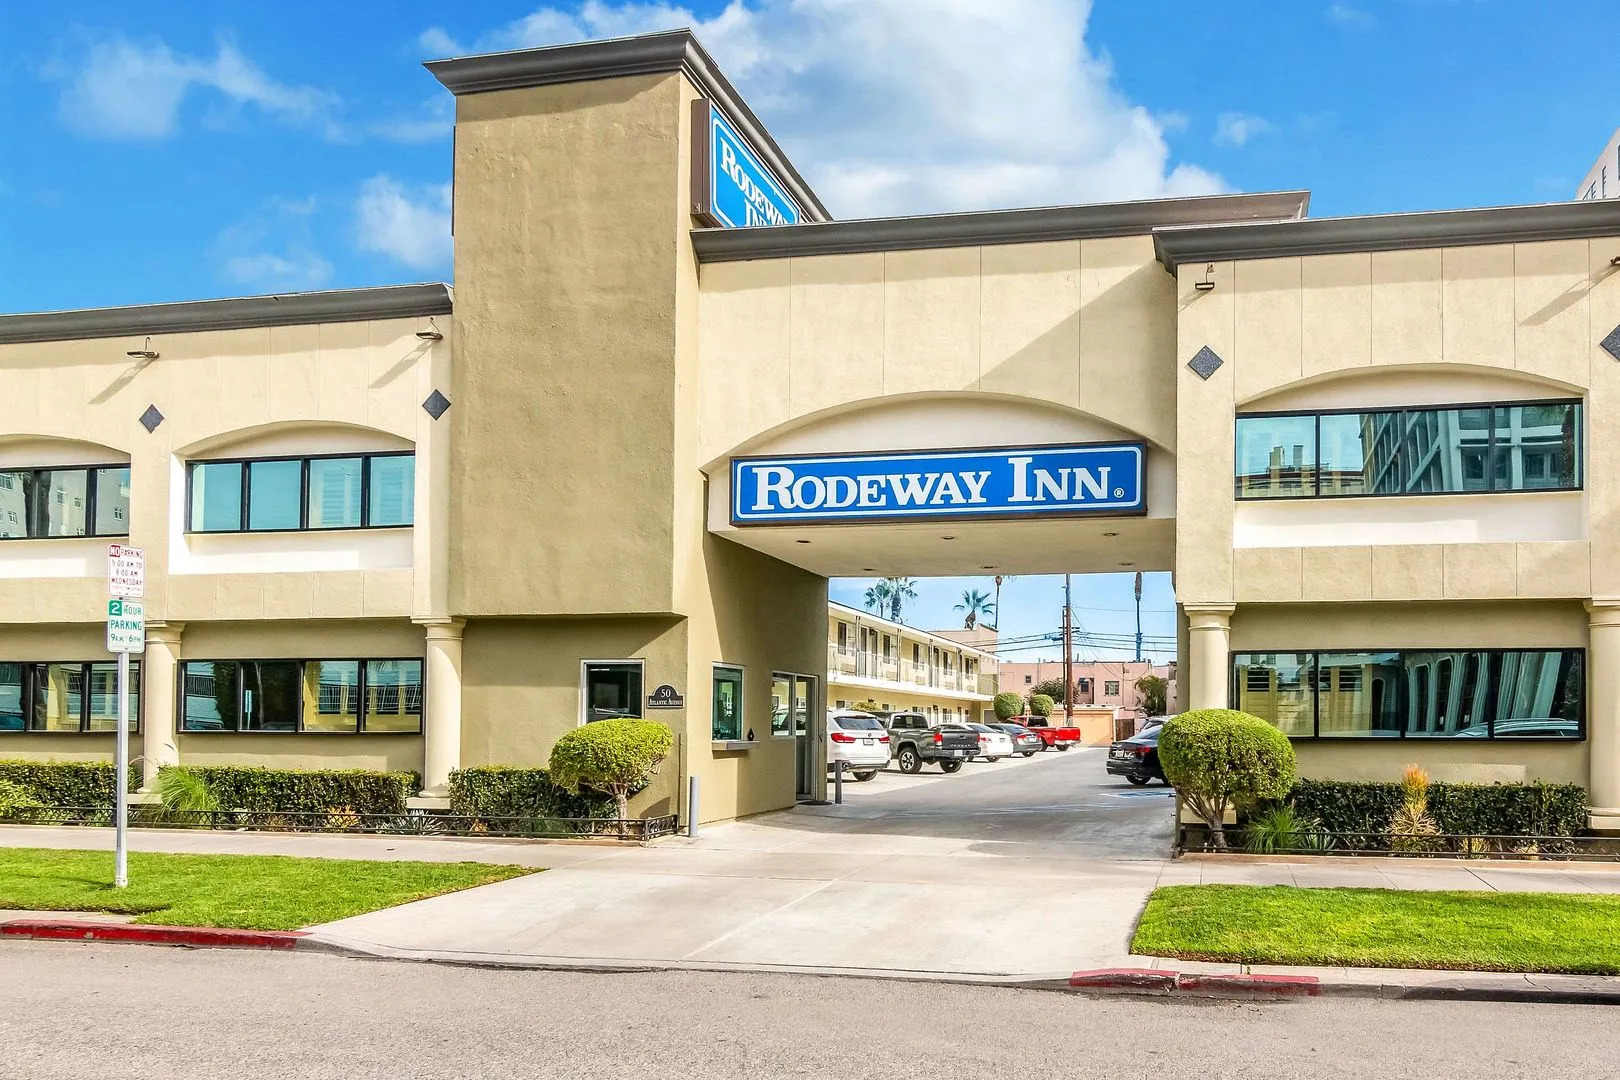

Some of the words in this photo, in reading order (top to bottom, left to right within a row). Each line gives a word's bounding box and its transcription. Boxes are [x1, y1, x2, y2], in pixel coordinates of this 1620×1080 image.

[751, 466, 991, 511] RODEWAY
[1007, 457, 1111, 502] INN
[110, 546, 120, 557] NO
[121, 548, 143, 559] PARKING
[112, 559, 125, 567] 500
[136, 561, 142, 570] TO
[116, 568, 128, 576] 800
[111, 577, 142, 586] WEDNESDAY
[111, 602, 120, 614] 2
[123, 605, 142, 615] HOUR
[111, 620, 142, 631] PARKING
[661, 689, 671, 698] 50
